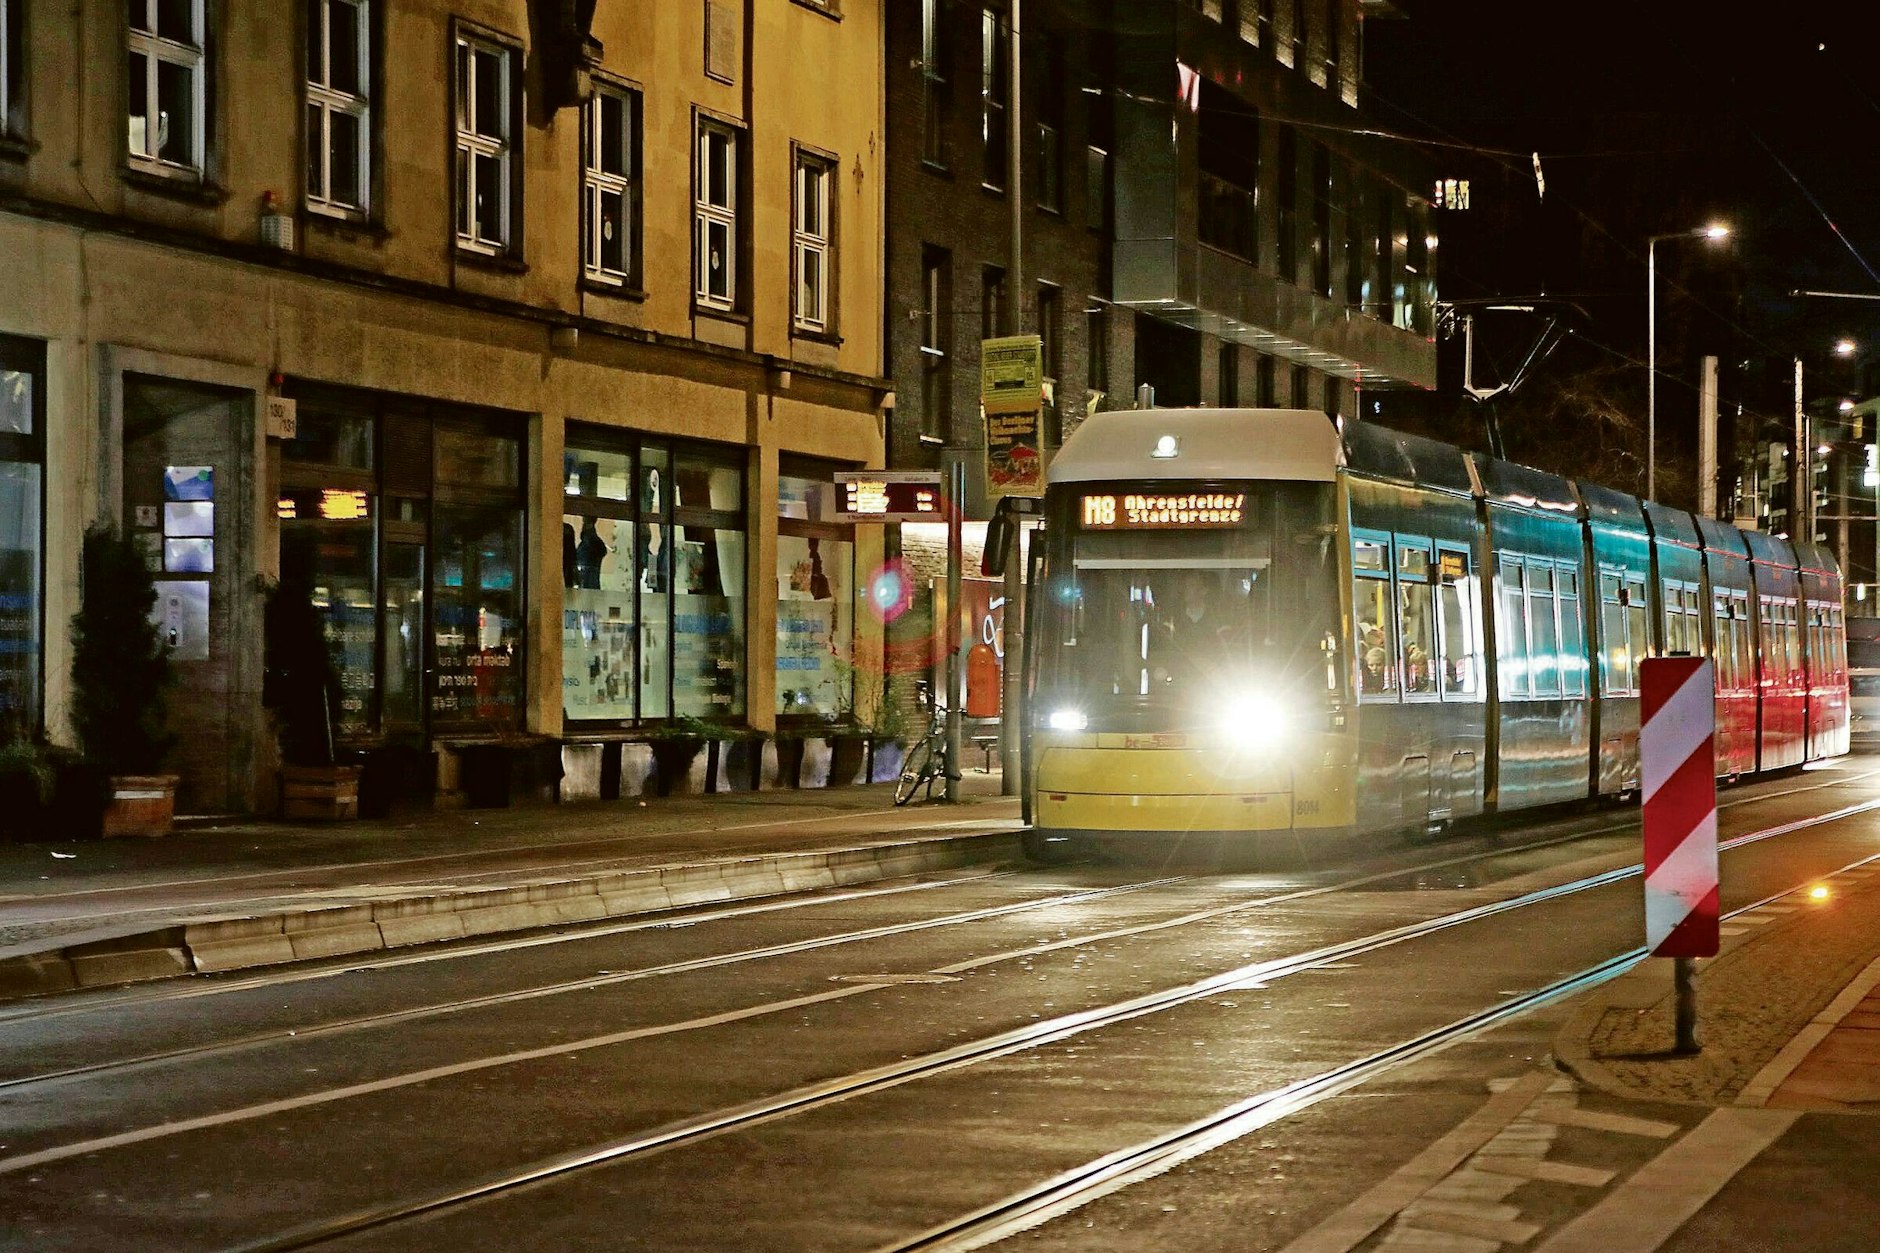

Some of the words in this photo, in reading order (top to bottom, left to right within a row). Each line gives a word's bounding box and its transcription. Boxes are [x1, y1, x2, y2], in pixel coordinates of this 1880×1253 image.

[1083, 495, 1116, 525] M8
[1124, 493, 1244, 510] Ahrensfelde/
[1127, 509, 1242, 524] Stadtgrenze
